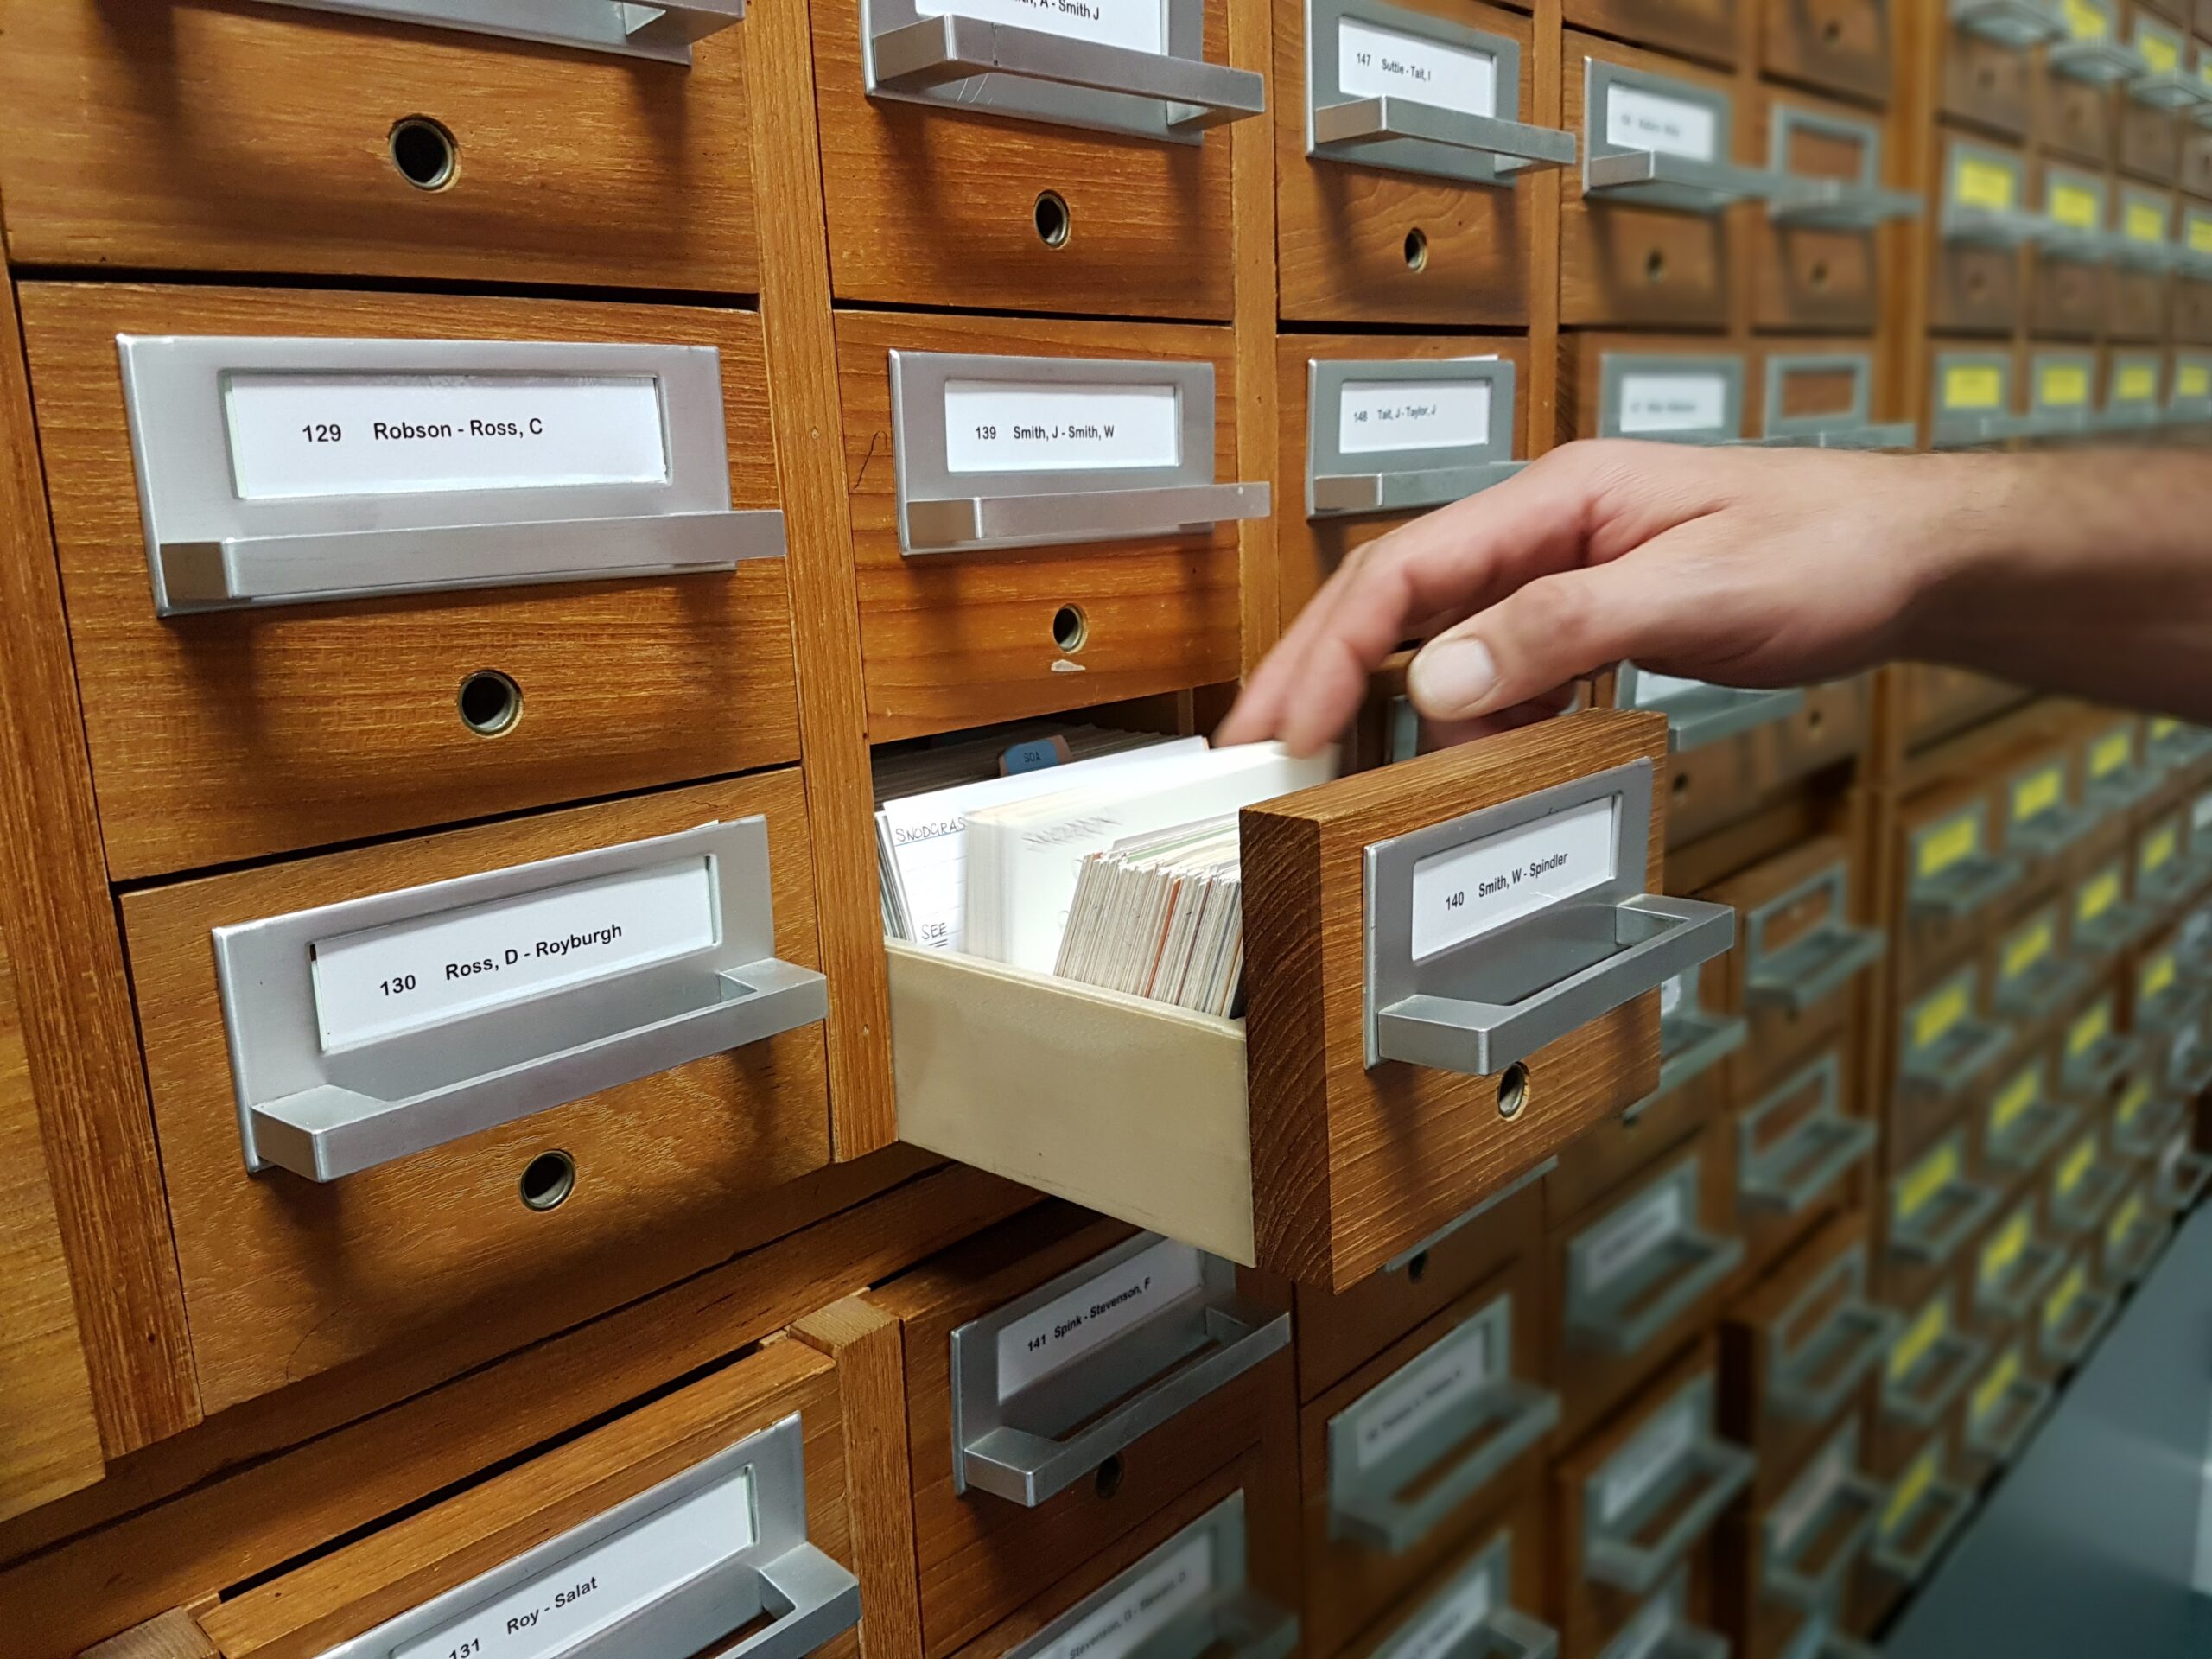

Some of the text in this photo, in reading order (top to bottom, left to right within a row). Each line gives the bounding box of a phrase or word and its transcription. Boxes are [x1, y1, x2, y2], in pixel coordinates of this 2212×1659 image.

[1040, 0, 1048, 9] A
[1059, 0, 1090, 18] Smith
[1093, 7, 1100, 20] J
[1357, 53, 1371, 67] 147
[302, 424, 342, 442] 129
[373, 422, 452, 441] Robson
[469, 419, 524, 438] Ross,
[529, 417, 543, 435] C
[975, 426, 996, 439] 139
[1014, 426, 1049, 442] Smith,
[1052, 426, 1058, 439] J
[1068, 425, 1102, 441] Smith,
[1103, 424, 1114, 438] W
[1446, 891, 1465, 911] 140
[1478, 874, 1510, 898] Smith,
[1512, 868, 1522, 885] W
[1529, 853, 1568, 879] Spindler
[921, 922, 947, 940] SEE
[379, 974, 416, 996] 130
[445, 958, 499, 980] Ross,
[505, 949, 518, 965] D
[536, 924, 622, 958] Royburgh
[1027, 1334, 1046, 1352] 141
[1054, 1315, 1082, 1339] Spink
[1089, 1285, 1142, 1319] Stevenson,
[1145, 1276, 1151, 1290] F
[448, 1637, 480, 1659] 131
[506, 1609, 539, 1635] Roy
[555, 1576, 599, 1609] Salat
